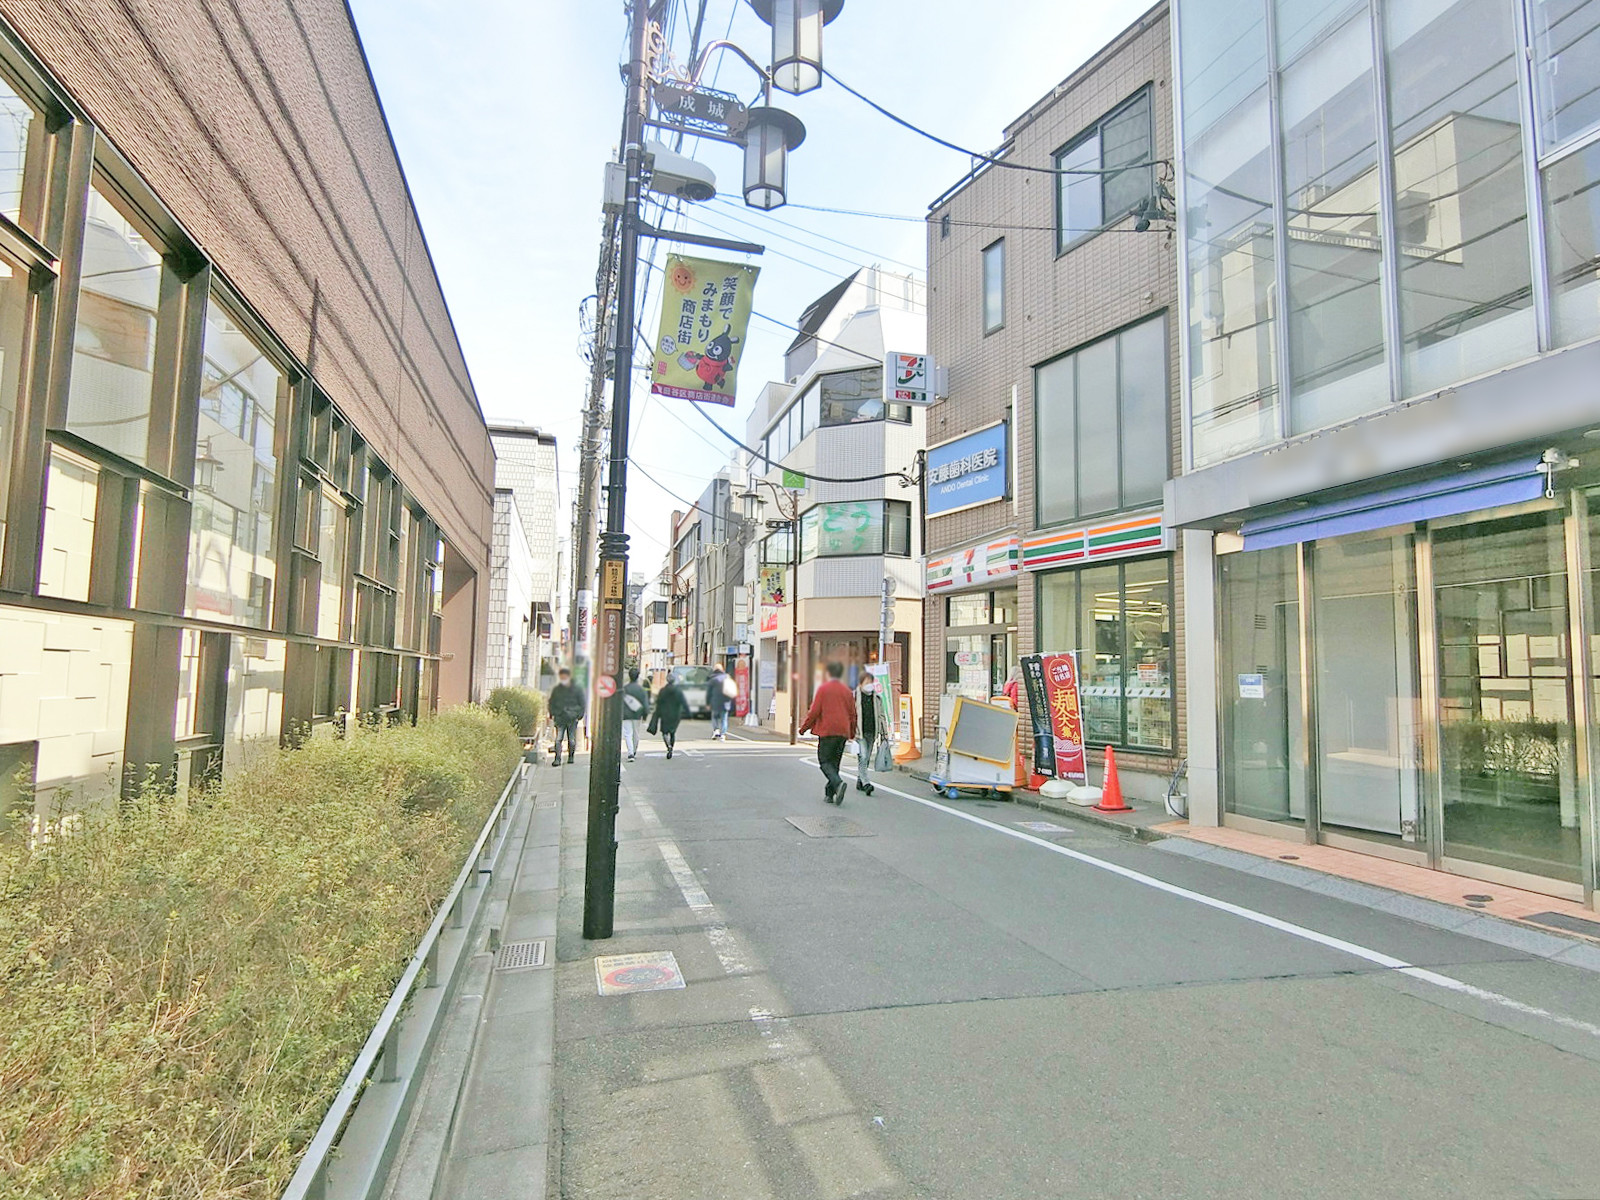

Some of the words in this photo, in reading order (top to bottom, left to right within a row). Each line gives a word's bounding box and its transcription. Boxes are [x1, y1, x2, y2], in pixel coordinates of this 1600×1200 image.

[678, 95, 725, 119] 成城
[697, 282, 719, 343] みまもり
[719, 276, 739, 320] 笑顔で
[676, 299, 697, 345] 商店街
[928, 447, 998, 486] 安藤歯科医院
[940, 483, 956, 495] ANDO
[957, 477, 974, 490] Dental
[974, 473, 990, 485] Clinic
[1051, 688, 1081, 746] 麺大集合
